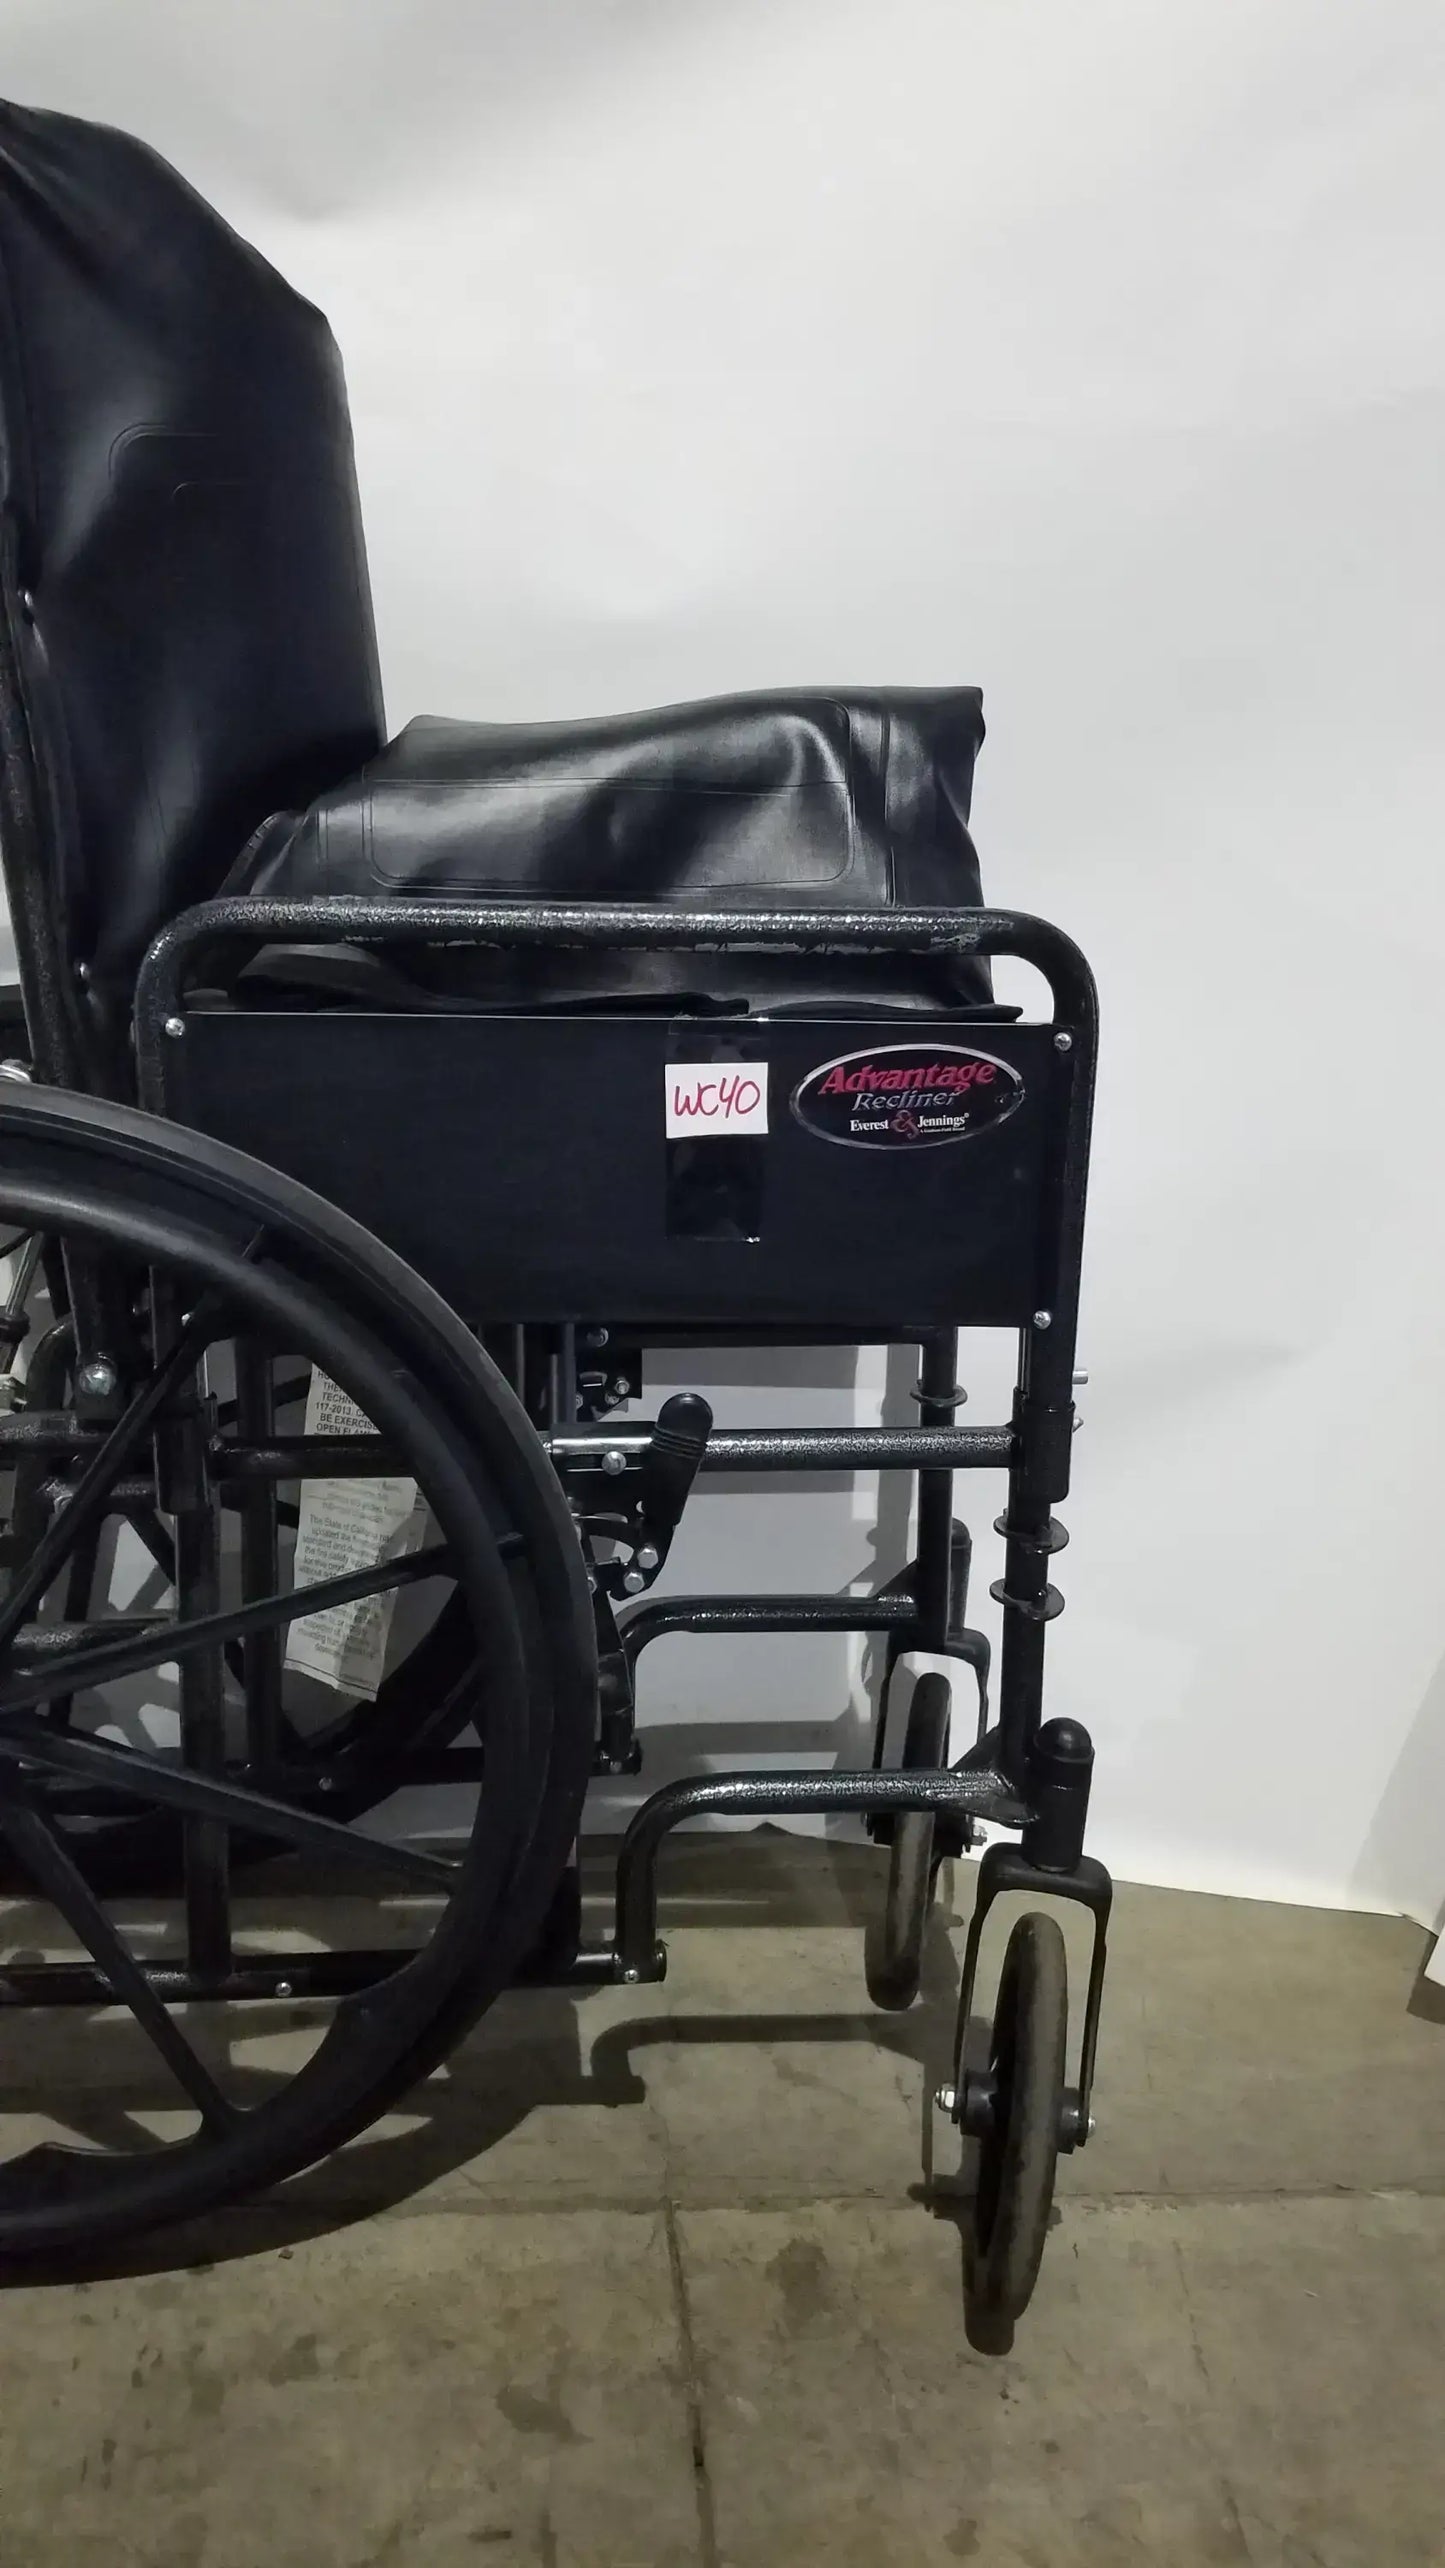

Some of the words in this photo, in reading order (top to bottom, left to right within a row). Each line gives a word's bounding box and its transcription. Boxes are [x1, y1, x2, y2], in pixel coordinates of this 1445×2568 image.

[816, 1061, 998, 1095] Advantage
[674, 1074, 761, 1119] WC40
[852, 1090, 960, 1111] Recliner
[850, 1119, 889, 1132] Everest
[890, 1109, 919, 1140] &
[316, 1423, 340, 1434] OPEN
[320, 1413, 333, 1423] BE
